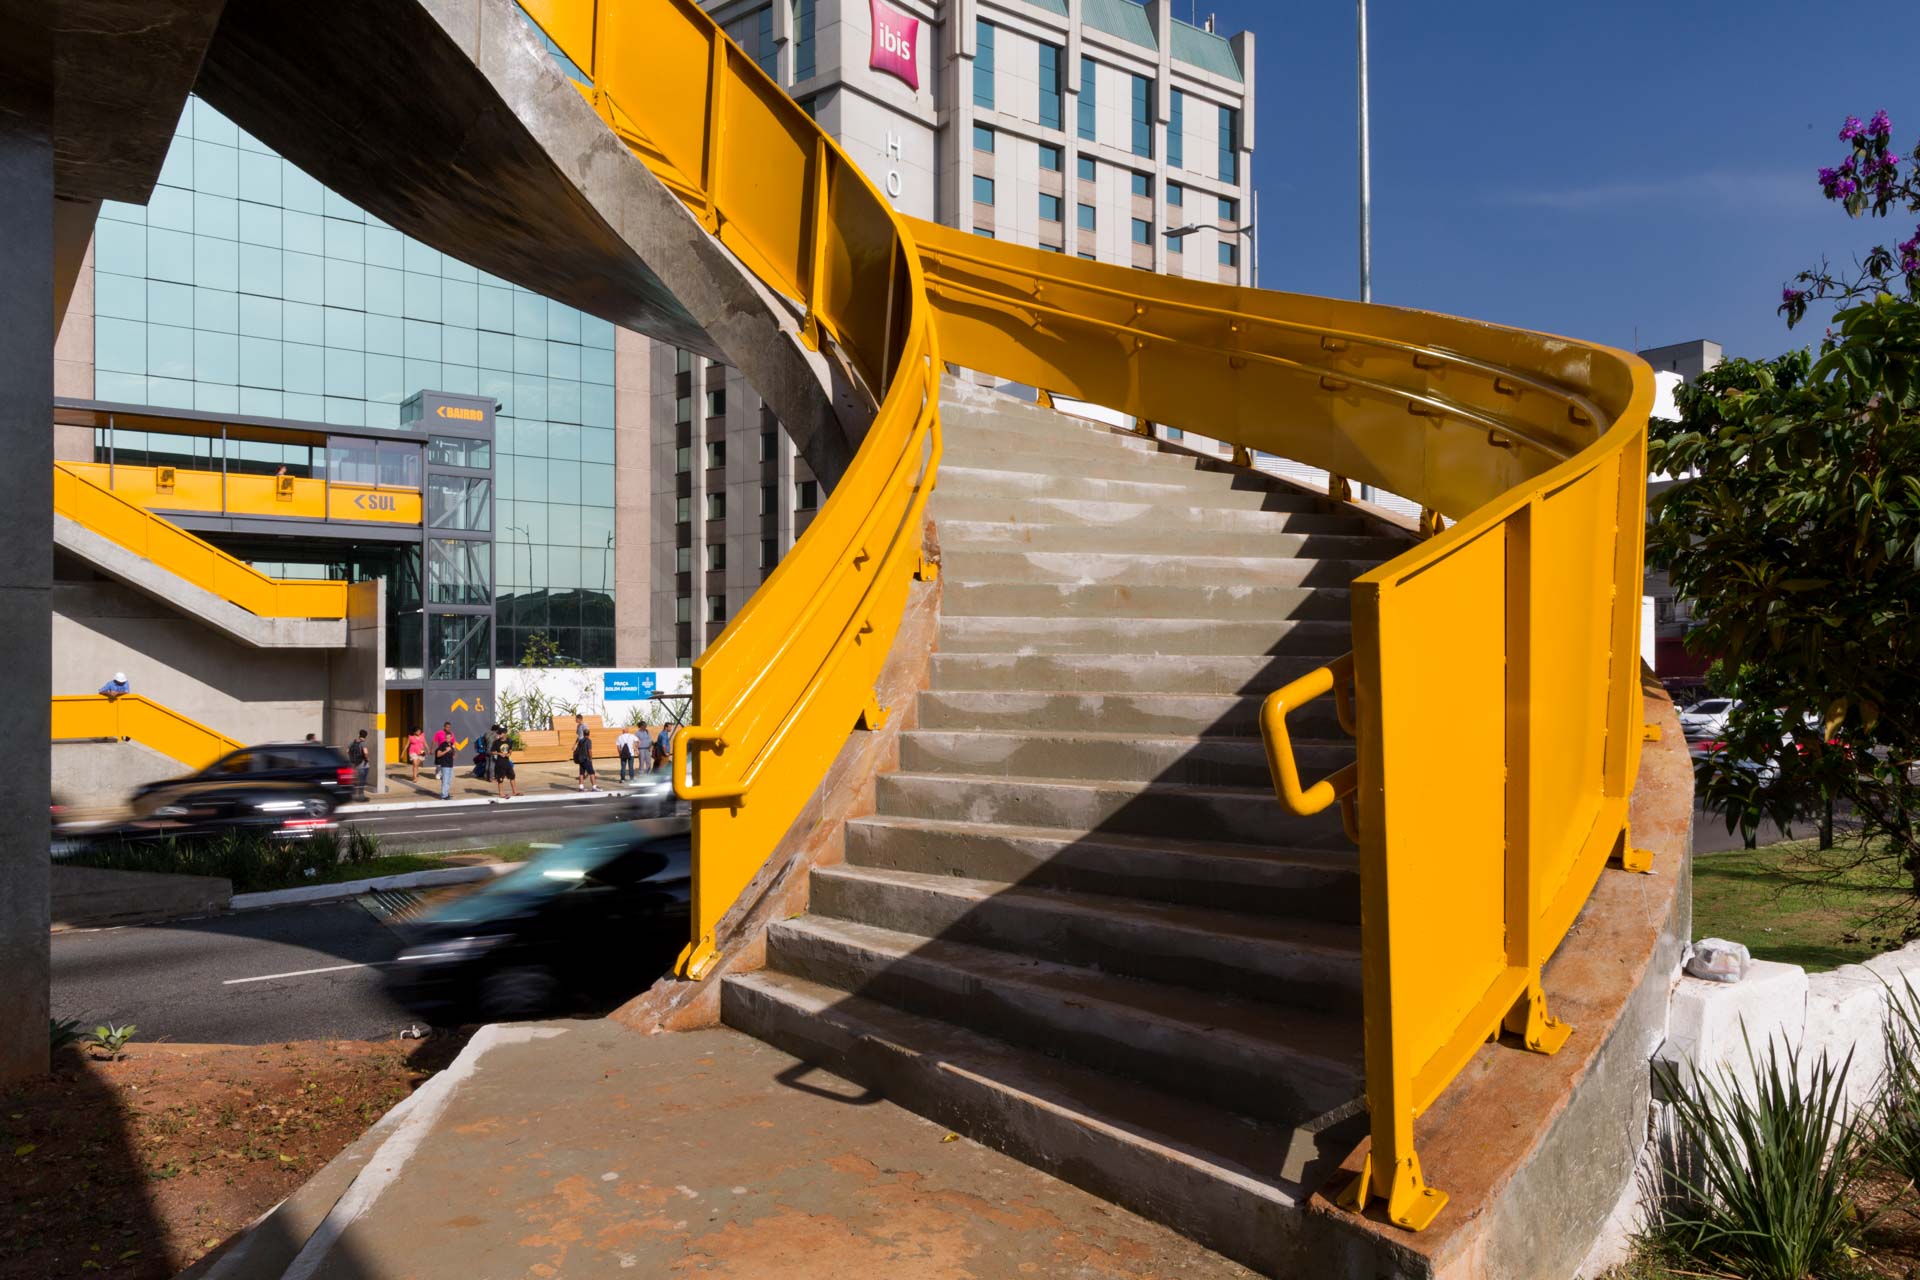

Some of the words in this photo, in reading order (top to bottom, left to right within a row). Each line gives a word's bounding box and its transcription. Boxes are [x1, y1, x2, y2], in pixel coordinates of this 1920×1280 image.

[880, 22, 910, 60] ibis
[887, 130, 902, 213] HO
[447, 407, 484, 421] BAIRRO
[368, 494, 397, 511] SUL
